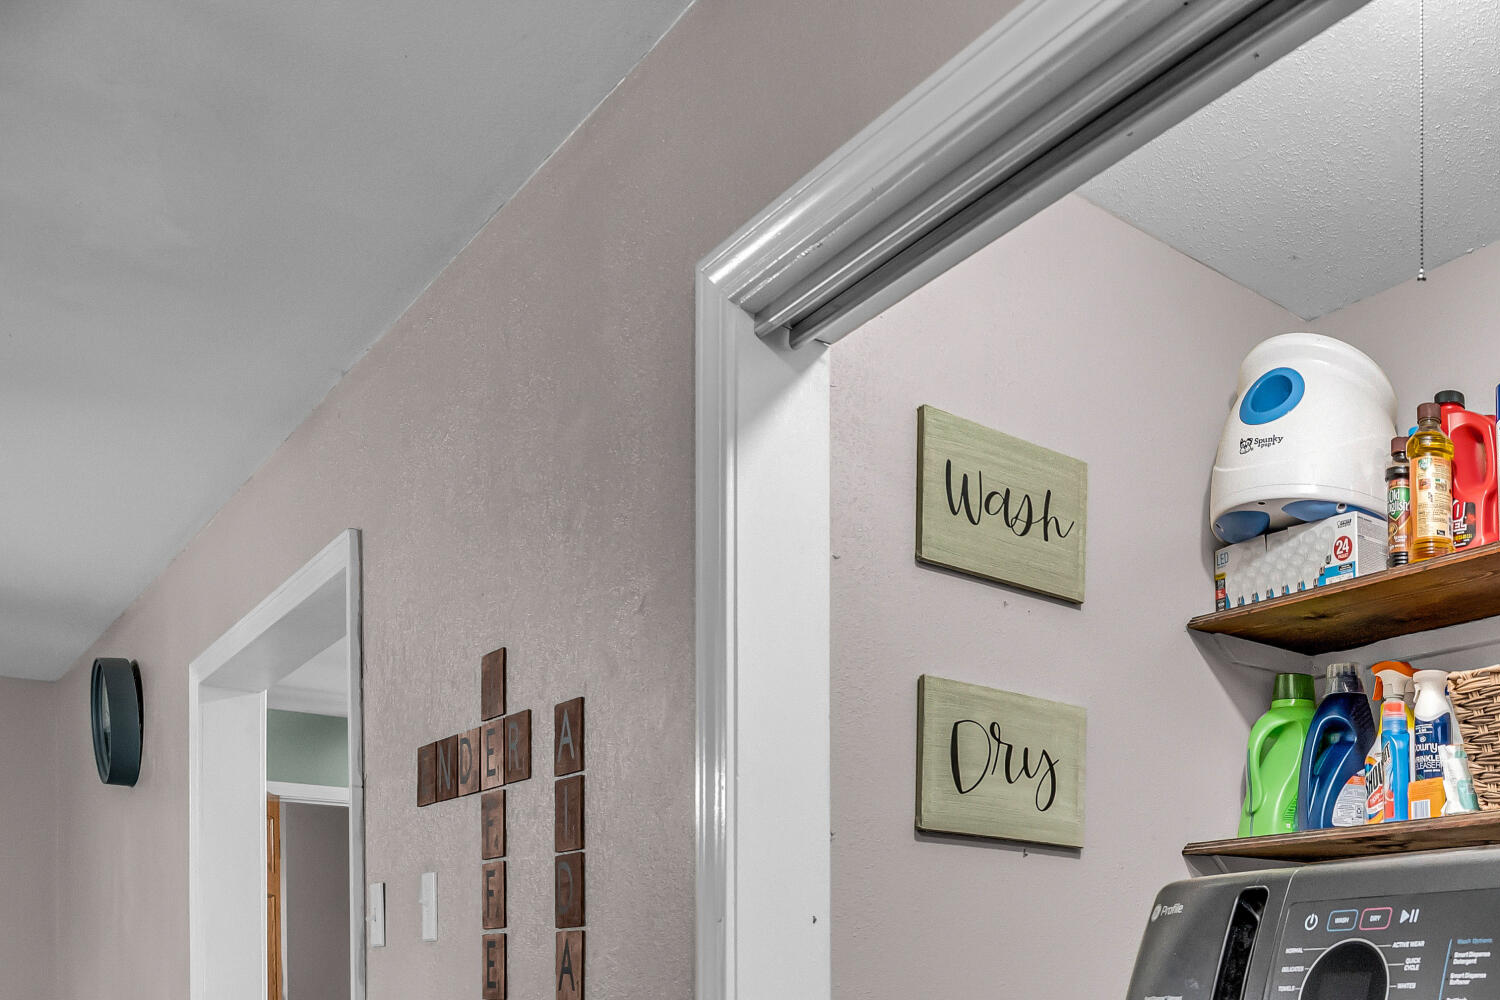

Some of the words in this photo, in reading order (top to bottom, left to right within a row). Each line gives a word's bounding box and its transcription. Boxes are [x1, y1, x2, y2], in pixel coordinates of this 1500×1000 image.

[1254, 434, 1284, 447] Spunky
[946, 458, 1075, 541] Wash
[1336, 538, 1350, 555] 24
[1216, 551, 1229, 566] LED
[1416, 743, 1438, 753] owny
[950, 719, 1060, 812] Dry
